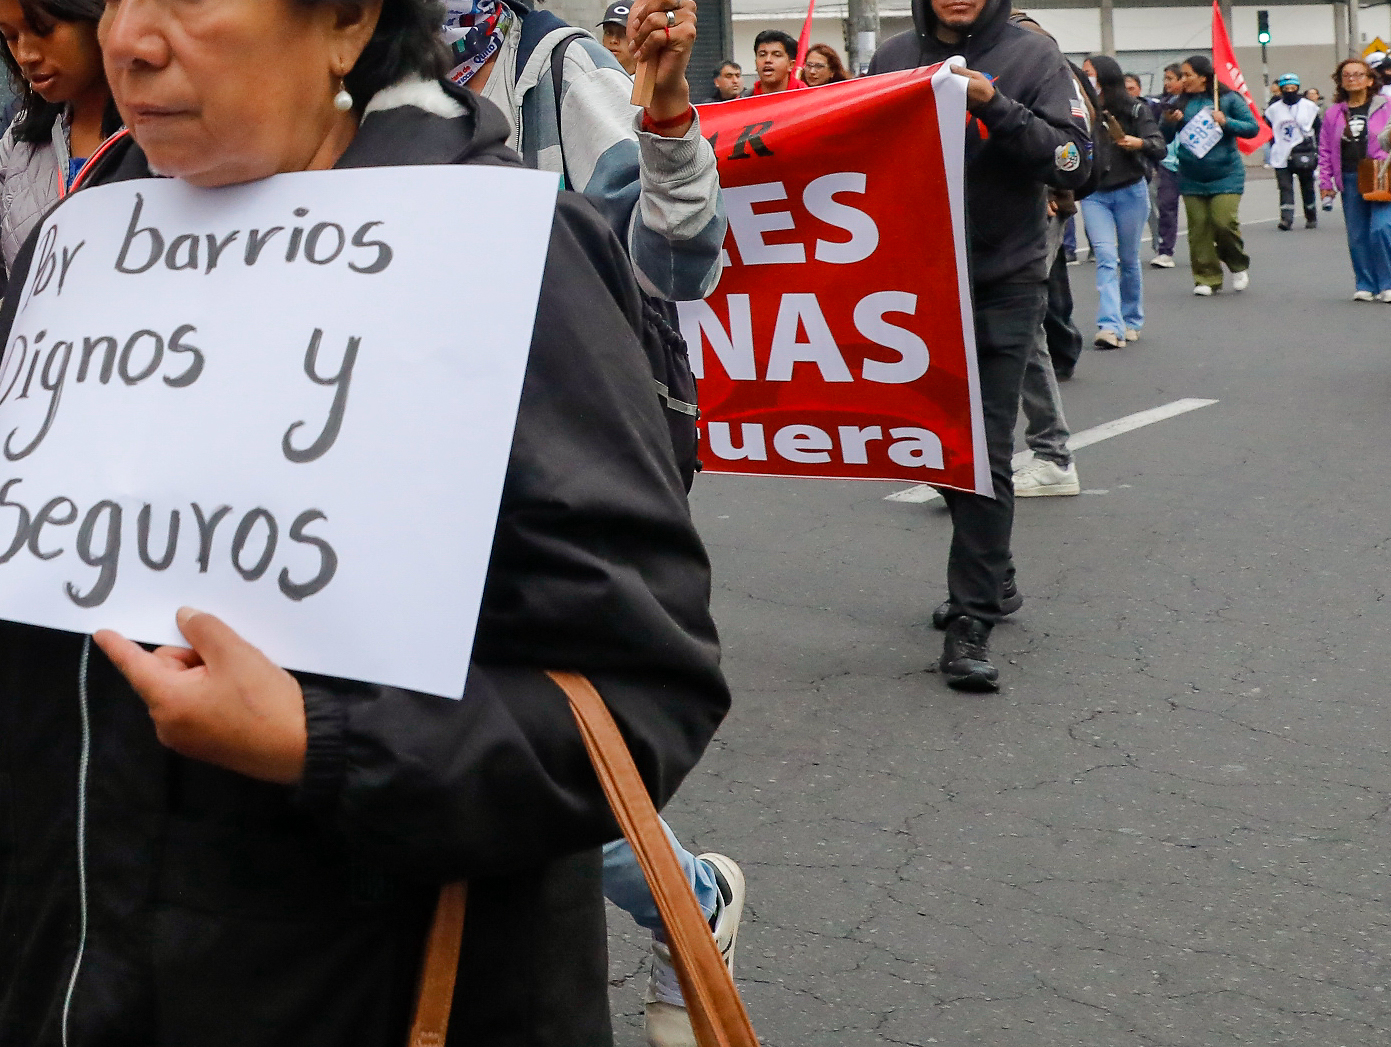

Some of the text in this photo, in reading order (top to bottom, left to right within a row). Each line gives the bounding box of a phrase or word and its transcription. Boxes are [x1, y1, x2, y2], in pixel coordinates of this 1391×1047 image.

[473, 43, 496, 64] Quito
[114, 192, 395, 275] barrios
[722, 171, 879, 268] ES
[281, 326, 362, 464] y
[697, 421, 945, 471] uera
